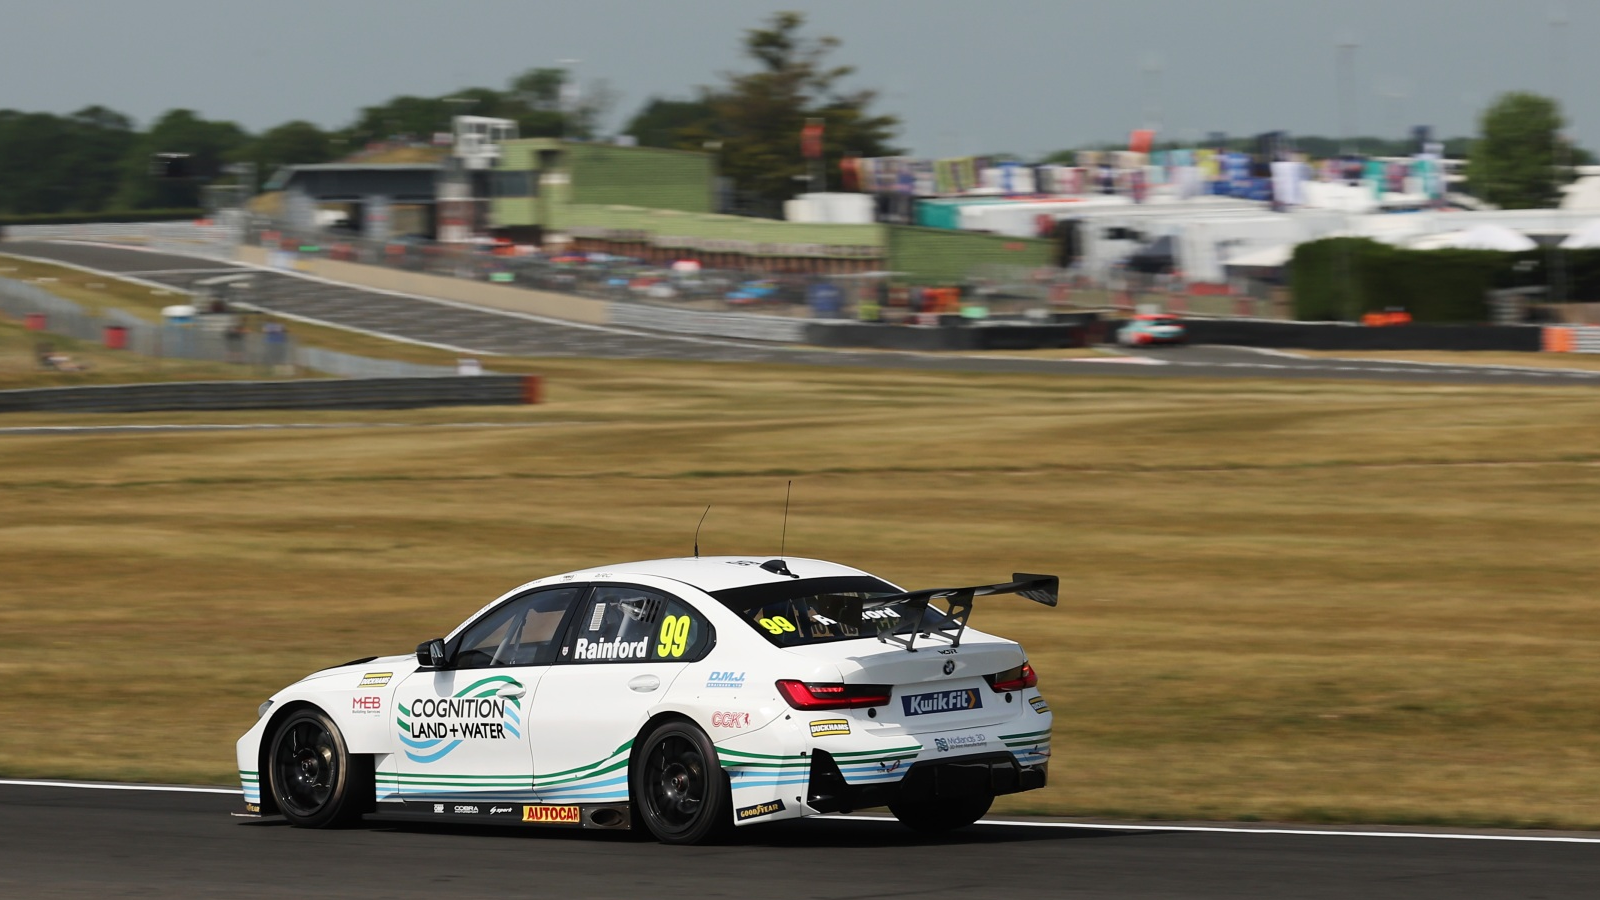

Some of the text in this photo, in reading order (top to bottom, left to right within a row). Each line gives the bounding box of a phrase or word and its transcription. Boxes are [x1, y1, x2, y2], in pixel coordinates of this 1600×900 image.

[759, 615, 796, 635] 99
[657, 615, 691, 657] 99
[574, 636, 649, 659] Rainford
[708, 671, 745, 681] D.M.J.
[352, 696, 381, 709] MEB
[411, 698, 505, 718] COGNITION
[712, 711, 744, 728] CCK
[811, 723, 850, 733] DUCKHAMS
[947, 734, 986, 745] Midlands 3D
[527, 806, 579, 821] AUTOCAR
[740, 804, 779, 818] GOODYEAR
